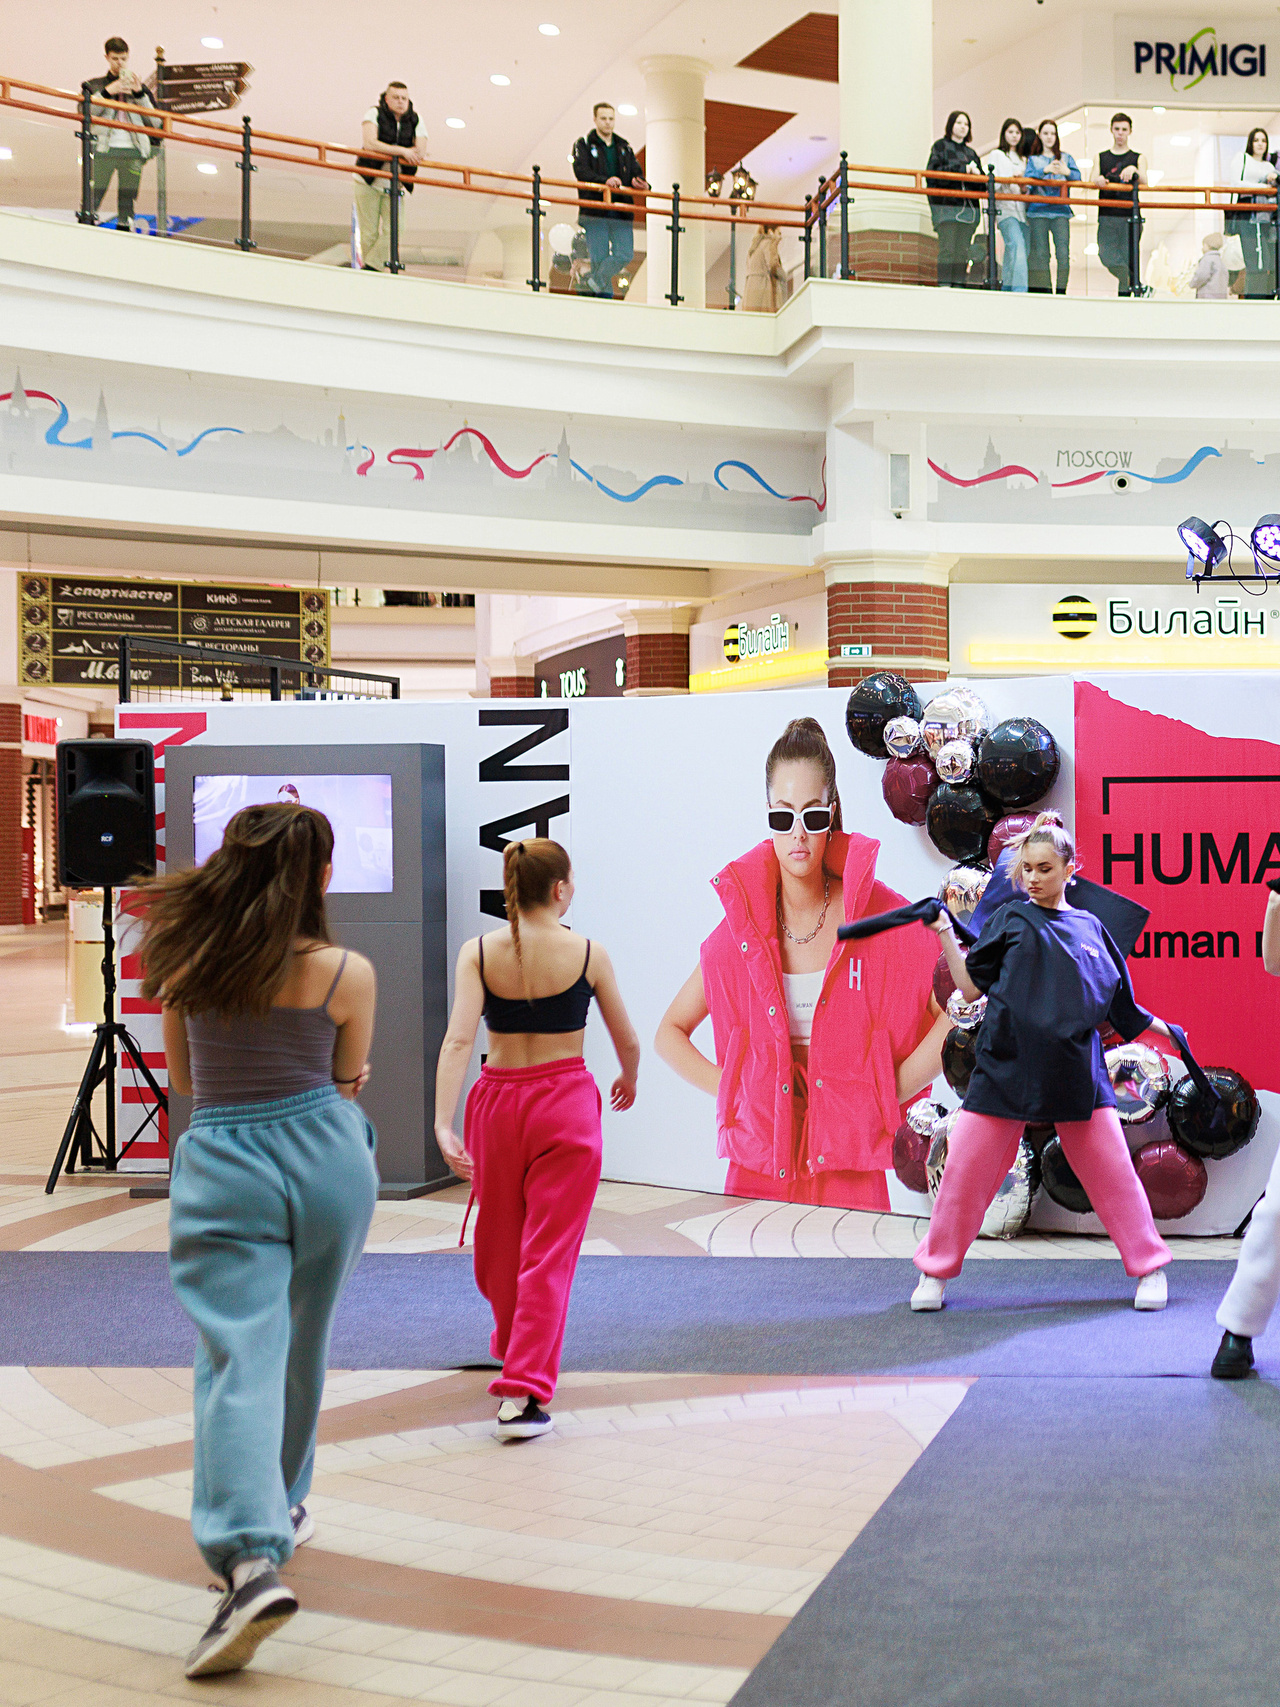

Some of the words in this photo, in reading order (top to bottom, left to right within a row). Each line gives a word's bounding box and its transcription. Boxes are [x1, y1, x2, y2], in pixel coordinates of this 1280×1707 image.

[1134, 41, 1266, 77] PRIMIGI
[1056, 450, 1133, 468] MOSCOW
[73, 586, 173, 603] спортмастер
[76, 610, 136, 621] РЕСТОРАНЫ
[1107, 598, 1267, 637] Билайн
[559, 667, 586, 698] TOUS
[1130, 931, 1240, 959] uman
[848, 958, 862, 991] H
